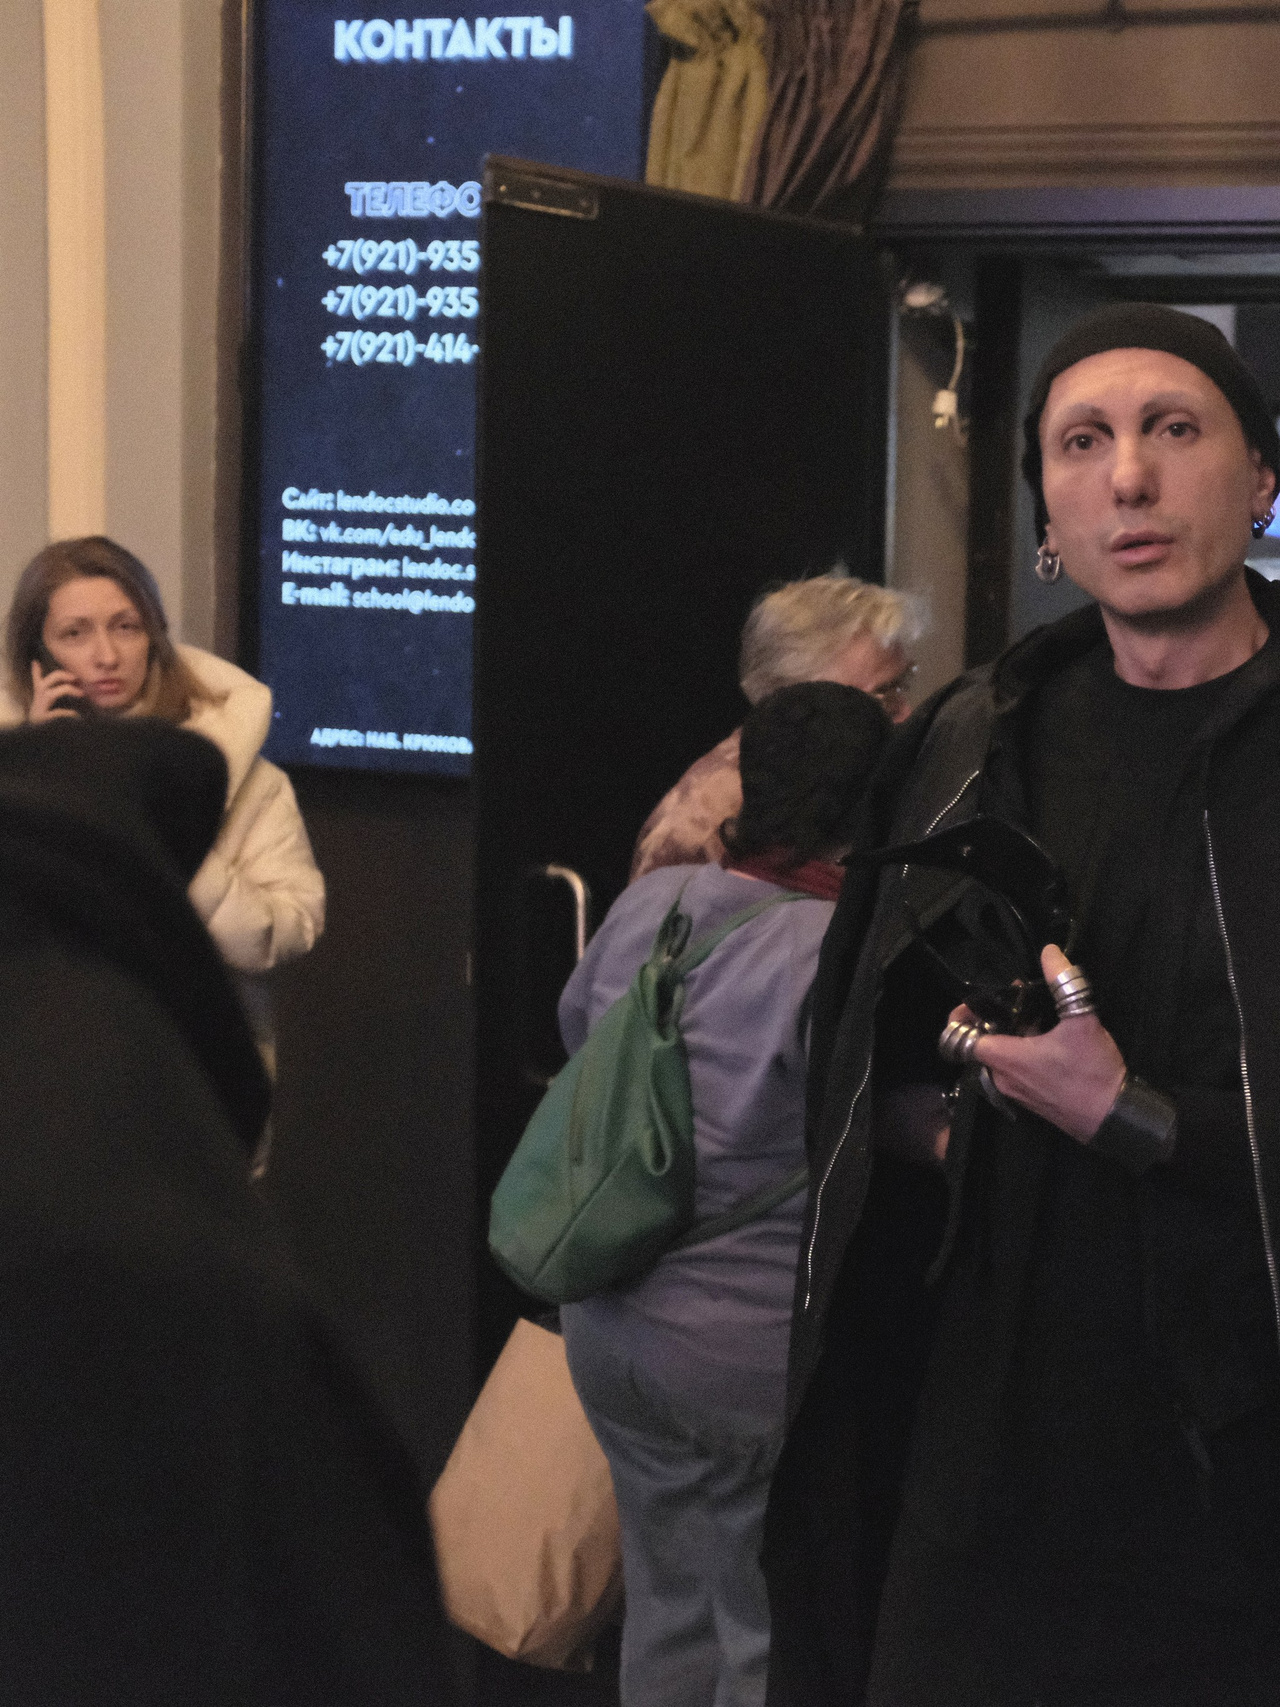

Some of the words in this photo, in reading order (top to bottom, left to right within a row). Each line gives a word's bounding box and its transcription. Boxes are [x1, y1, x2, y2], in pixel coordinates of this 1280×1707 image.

[334, 15, 573, 62] КОНТАКТЫ
[282, 487, 335, 511] Сайт:
[282, 519, 318, 542] ВК:
[282, 550, 400, 580] Инстаграм:
[282, 582, 350, 607] E-mail:
